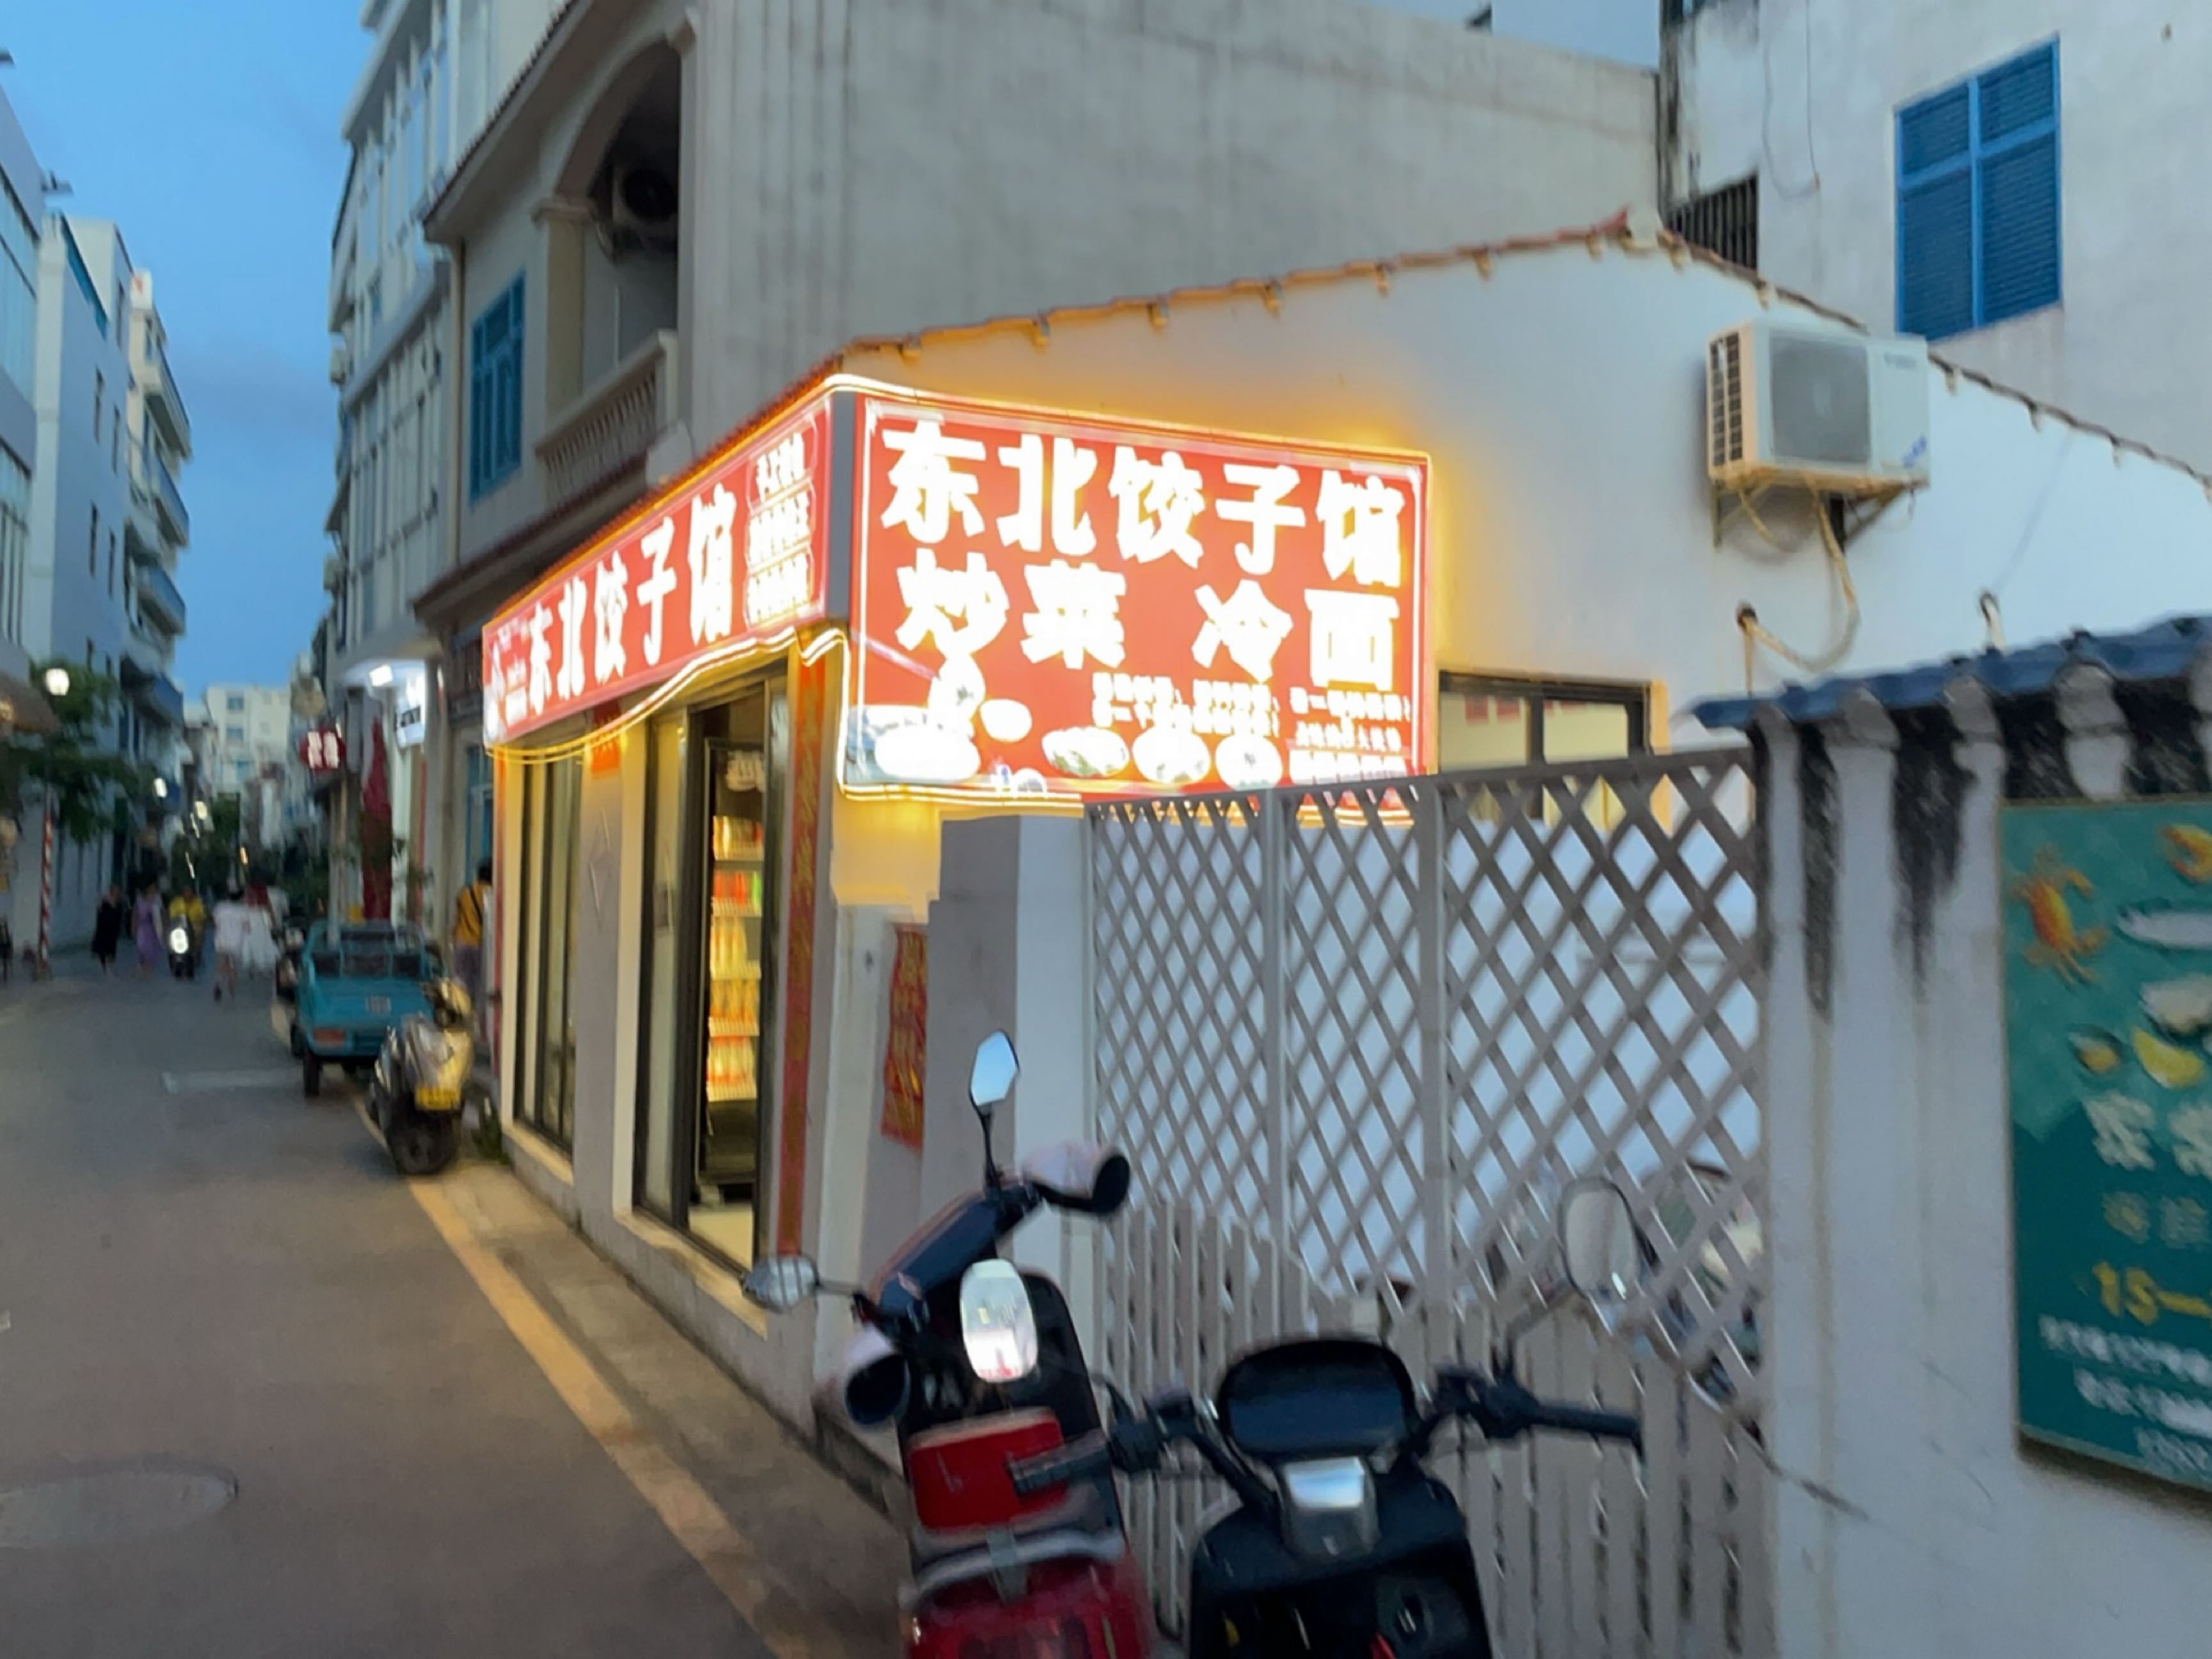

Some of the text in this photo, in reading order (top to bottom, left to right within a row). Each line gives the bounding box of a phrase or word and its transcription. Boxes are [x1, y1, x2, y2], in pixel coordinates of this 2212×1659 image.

[881, 413, 1404, 587] 东北饺子馆
[529, 483, 737, 716] 东北饺子馆
[895, 549, 1126, 669] 炒菜
[1192, 580, 1400, 691] 冷面
